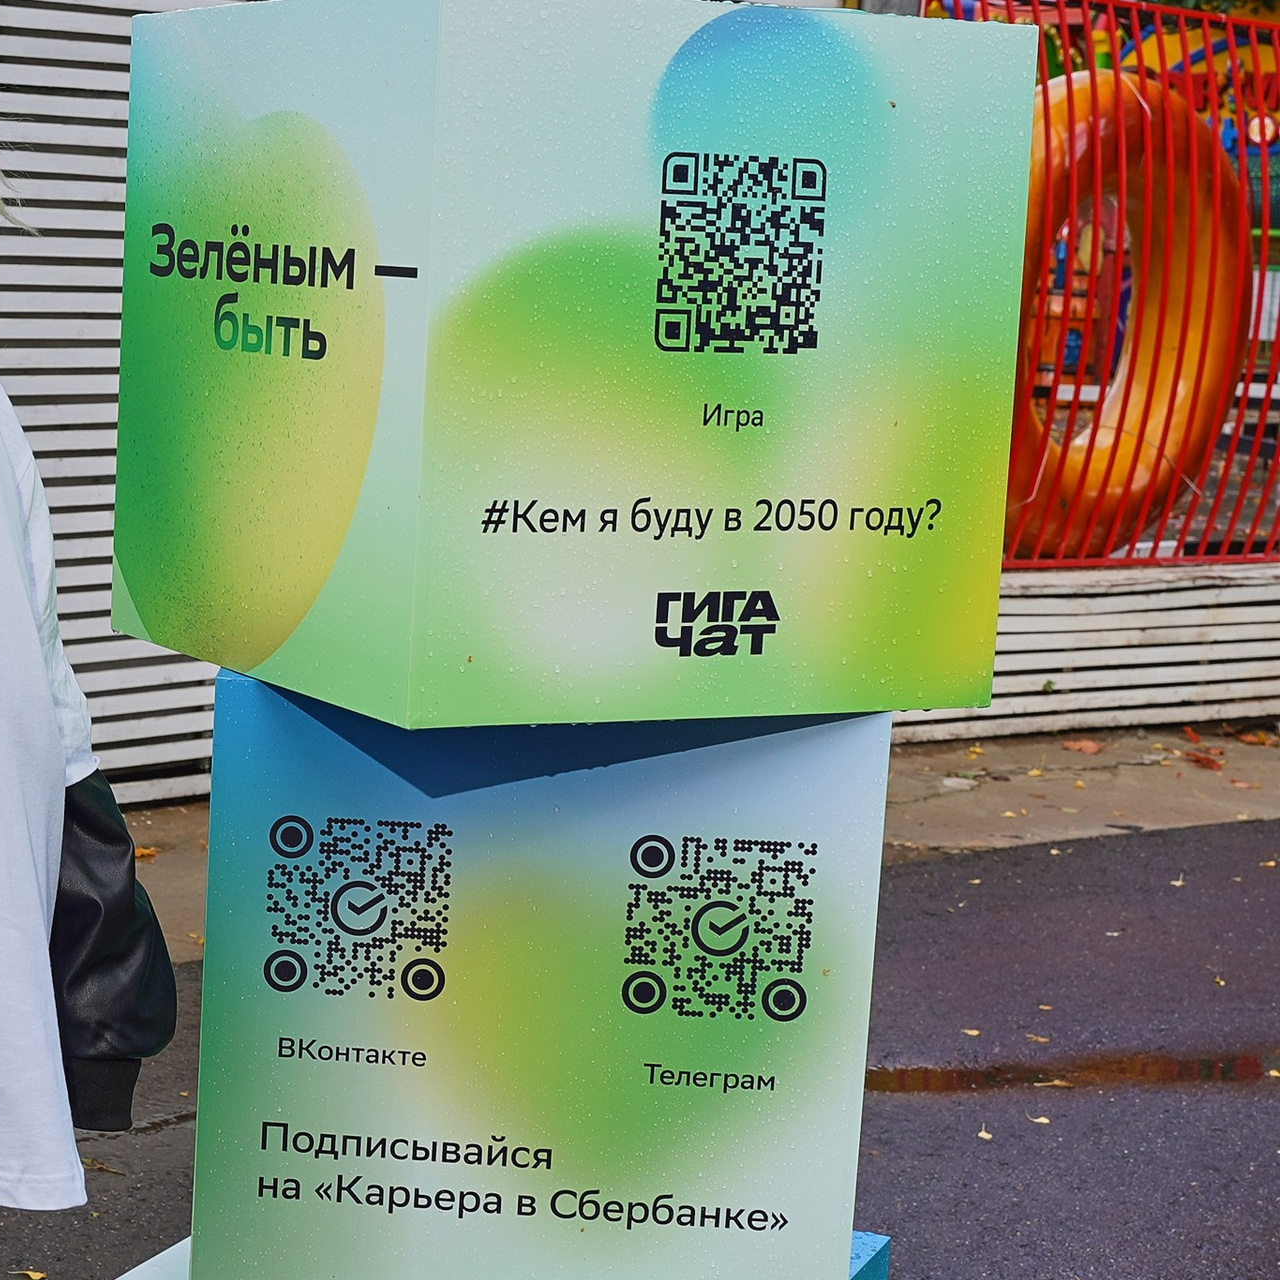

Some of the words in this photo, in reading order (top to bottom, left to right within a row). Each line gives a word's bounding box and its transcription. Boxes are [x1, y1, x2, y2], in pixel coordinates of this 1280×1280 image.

[149, 222, 356, 290] Зелёным
[213, 291, 328, 361] быть
[702, 403, 764, 433] Игра
[481, 499, 586, 534] #Кем
[598, 508, 618, 533] я
[631, 496, 713, 541] буду
[724, 508, 742, 532] в
[753, 498, 838, 532] 2050
[849, 498, 942, 539] году?
[655, 590, 781, 624] ГИГА
[277, 1036, 427, 1068] ВКонтакте
[643, 1063, 776, 1094] Телеграм
[260, 1121, 553, 1171] Подписывайся
[257, 1176, 301, 1200] на
[314, 1174, 502, 1219] «Карьера
[517, 1194, 537, 1216] в
[550, 1189, 789, 1232] Сбербанке»
